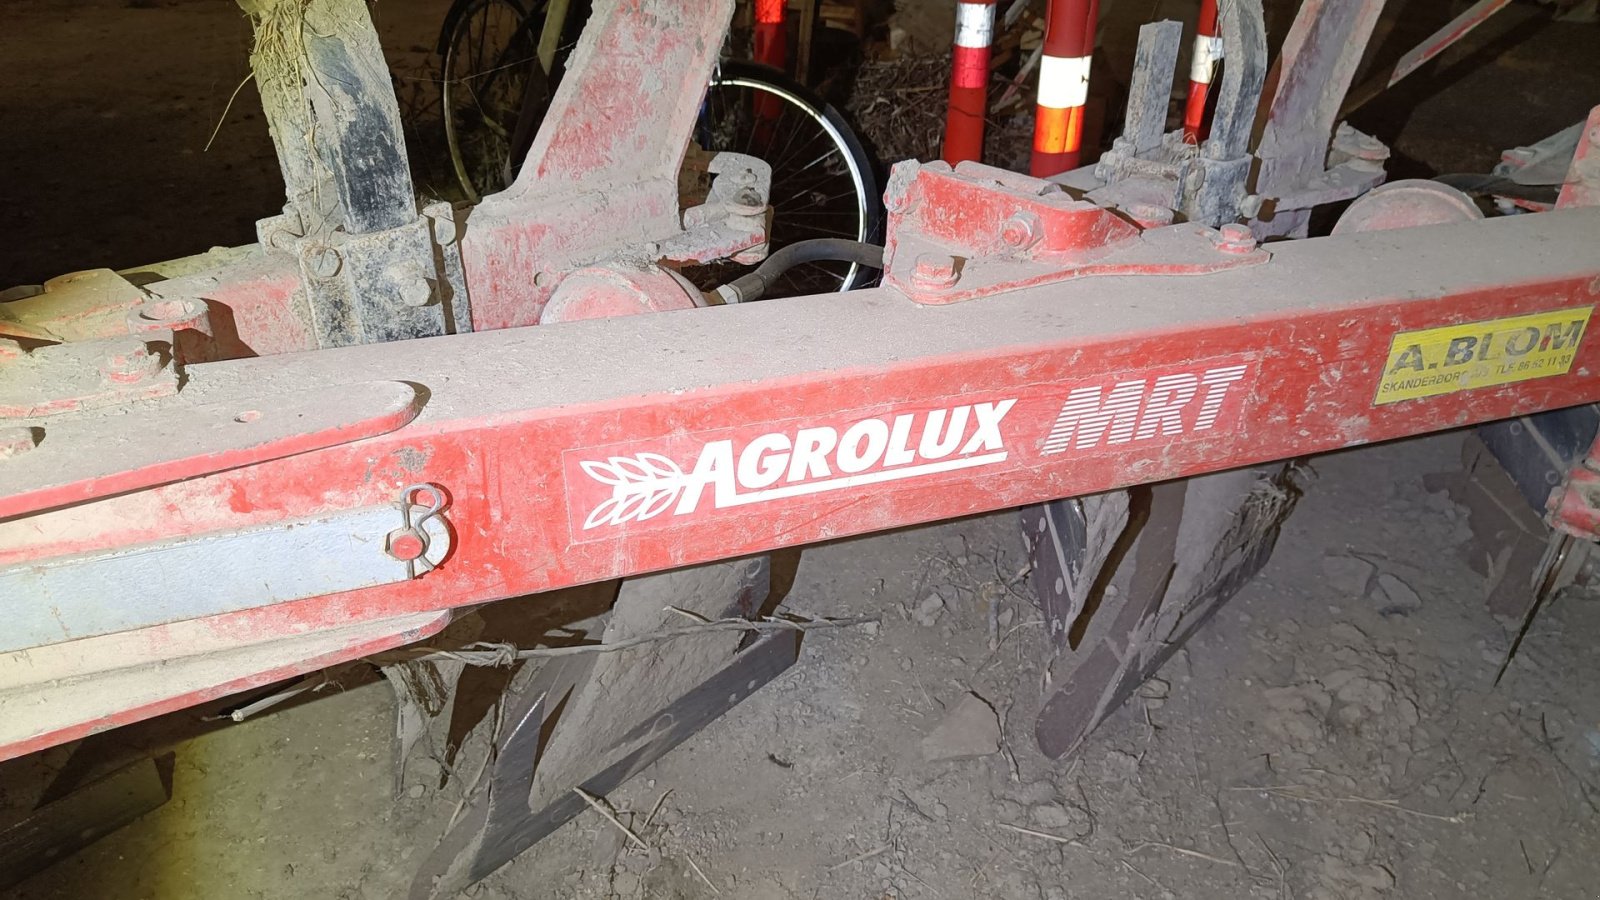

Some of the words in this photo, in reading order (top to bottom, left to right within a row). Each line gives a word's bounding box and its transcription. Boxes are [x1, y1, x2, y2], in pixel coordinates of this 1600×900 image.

[1389, 319, 1585, 375] A.BLOM
[673, 398, 1018, 516] AGROLUX
[1039, 365, 1248, 457] MRT
